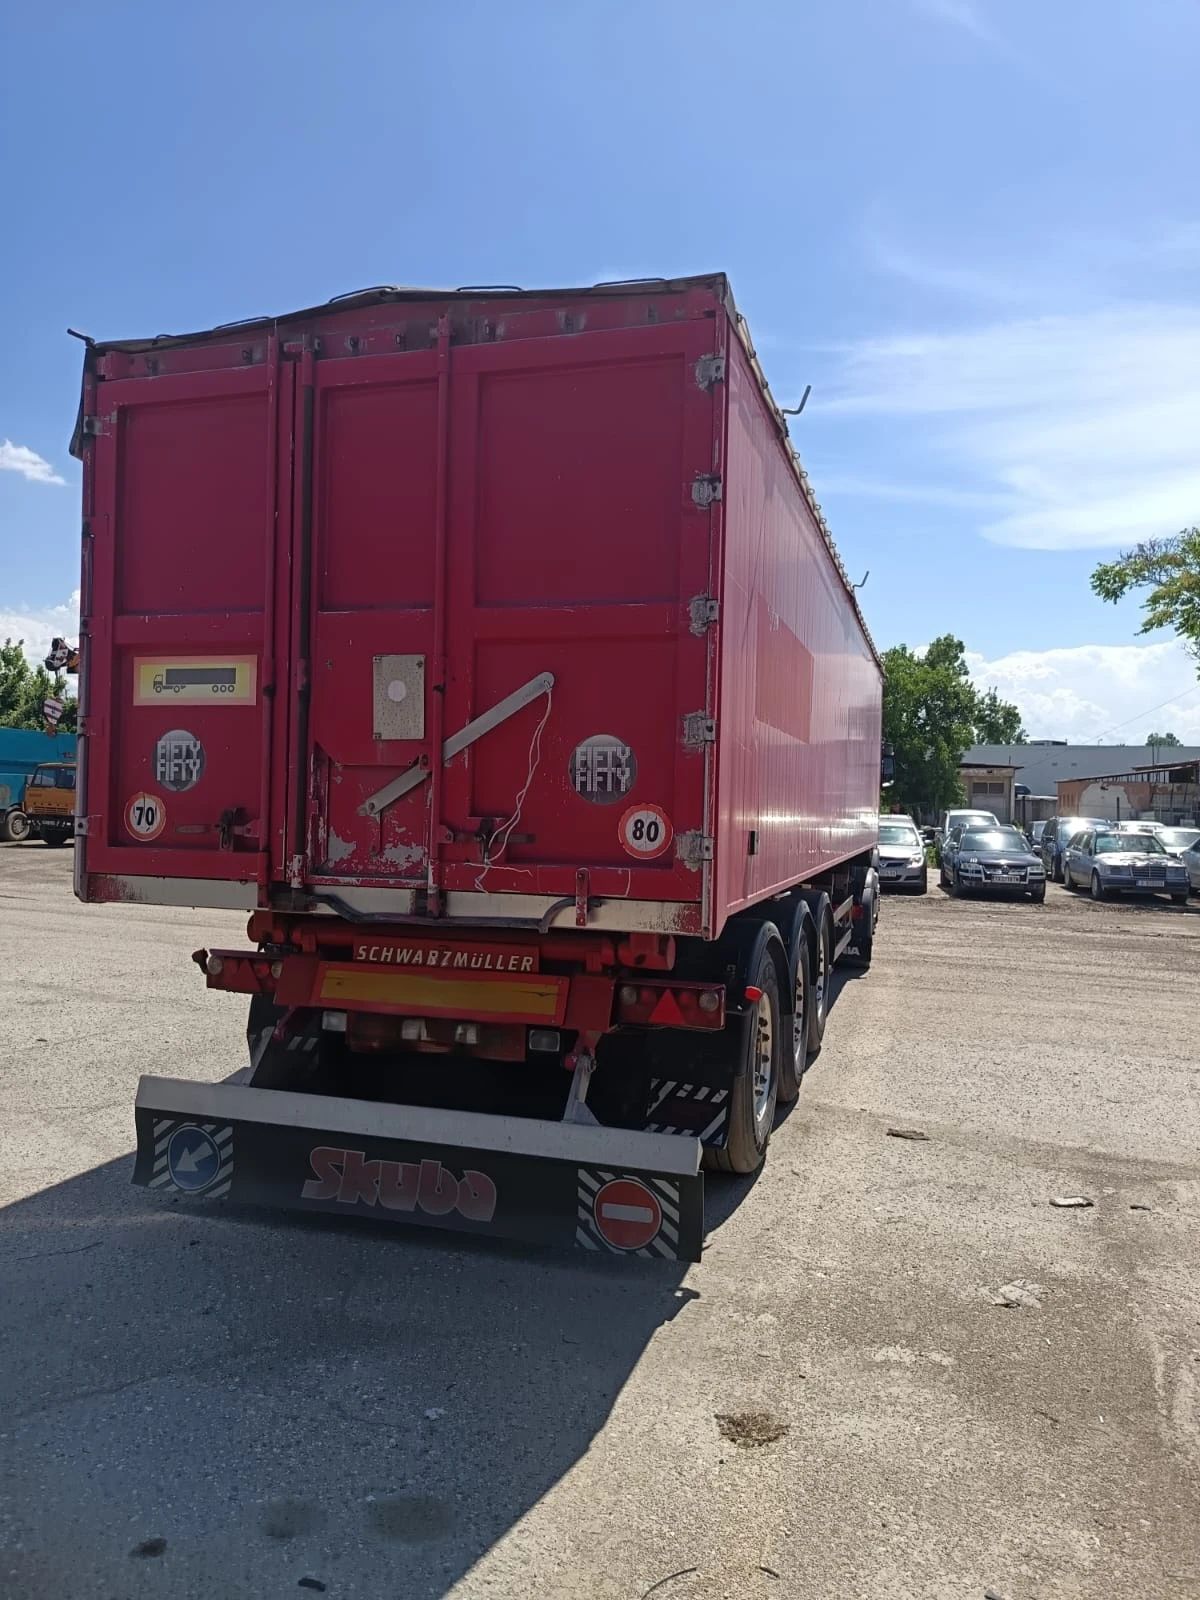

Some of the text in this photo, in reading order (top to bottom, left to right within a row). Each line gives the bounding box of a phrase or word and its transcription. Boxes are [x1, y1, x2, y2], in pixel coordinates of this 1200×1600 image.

[157, 741, 200, 761] FIFTY
[576, 747, 630, 769] FIFTY
[157, 760, 200, 781] FIFTY
[576, 768, 630, 791] FIFTY
[136, 806, 155, 826] 70
[632, 818, 659, 842] 80
